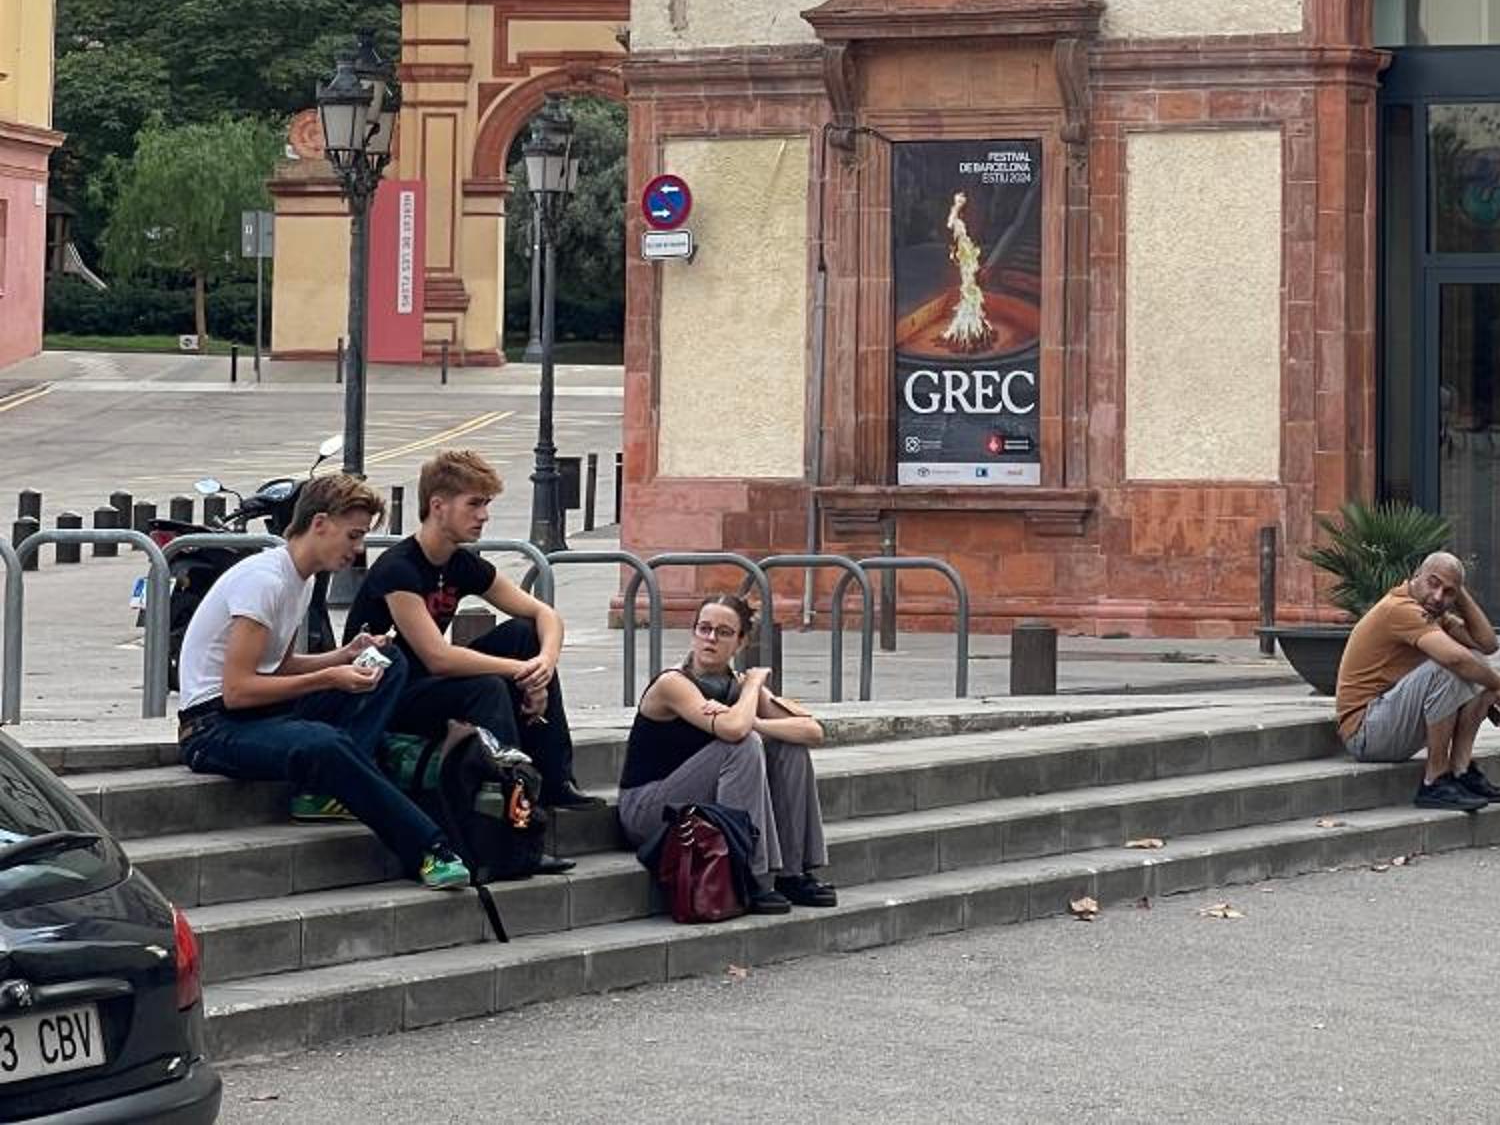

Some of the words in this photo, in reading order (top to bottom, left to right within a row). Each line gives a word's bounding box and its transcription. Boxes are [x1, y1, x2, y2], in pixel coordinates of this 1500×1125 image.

[988, 151, 1032, 162] FESTIVAL
[904, 370, 1035, 414] GREC
[38, 1010, 91, 1065] CBV
